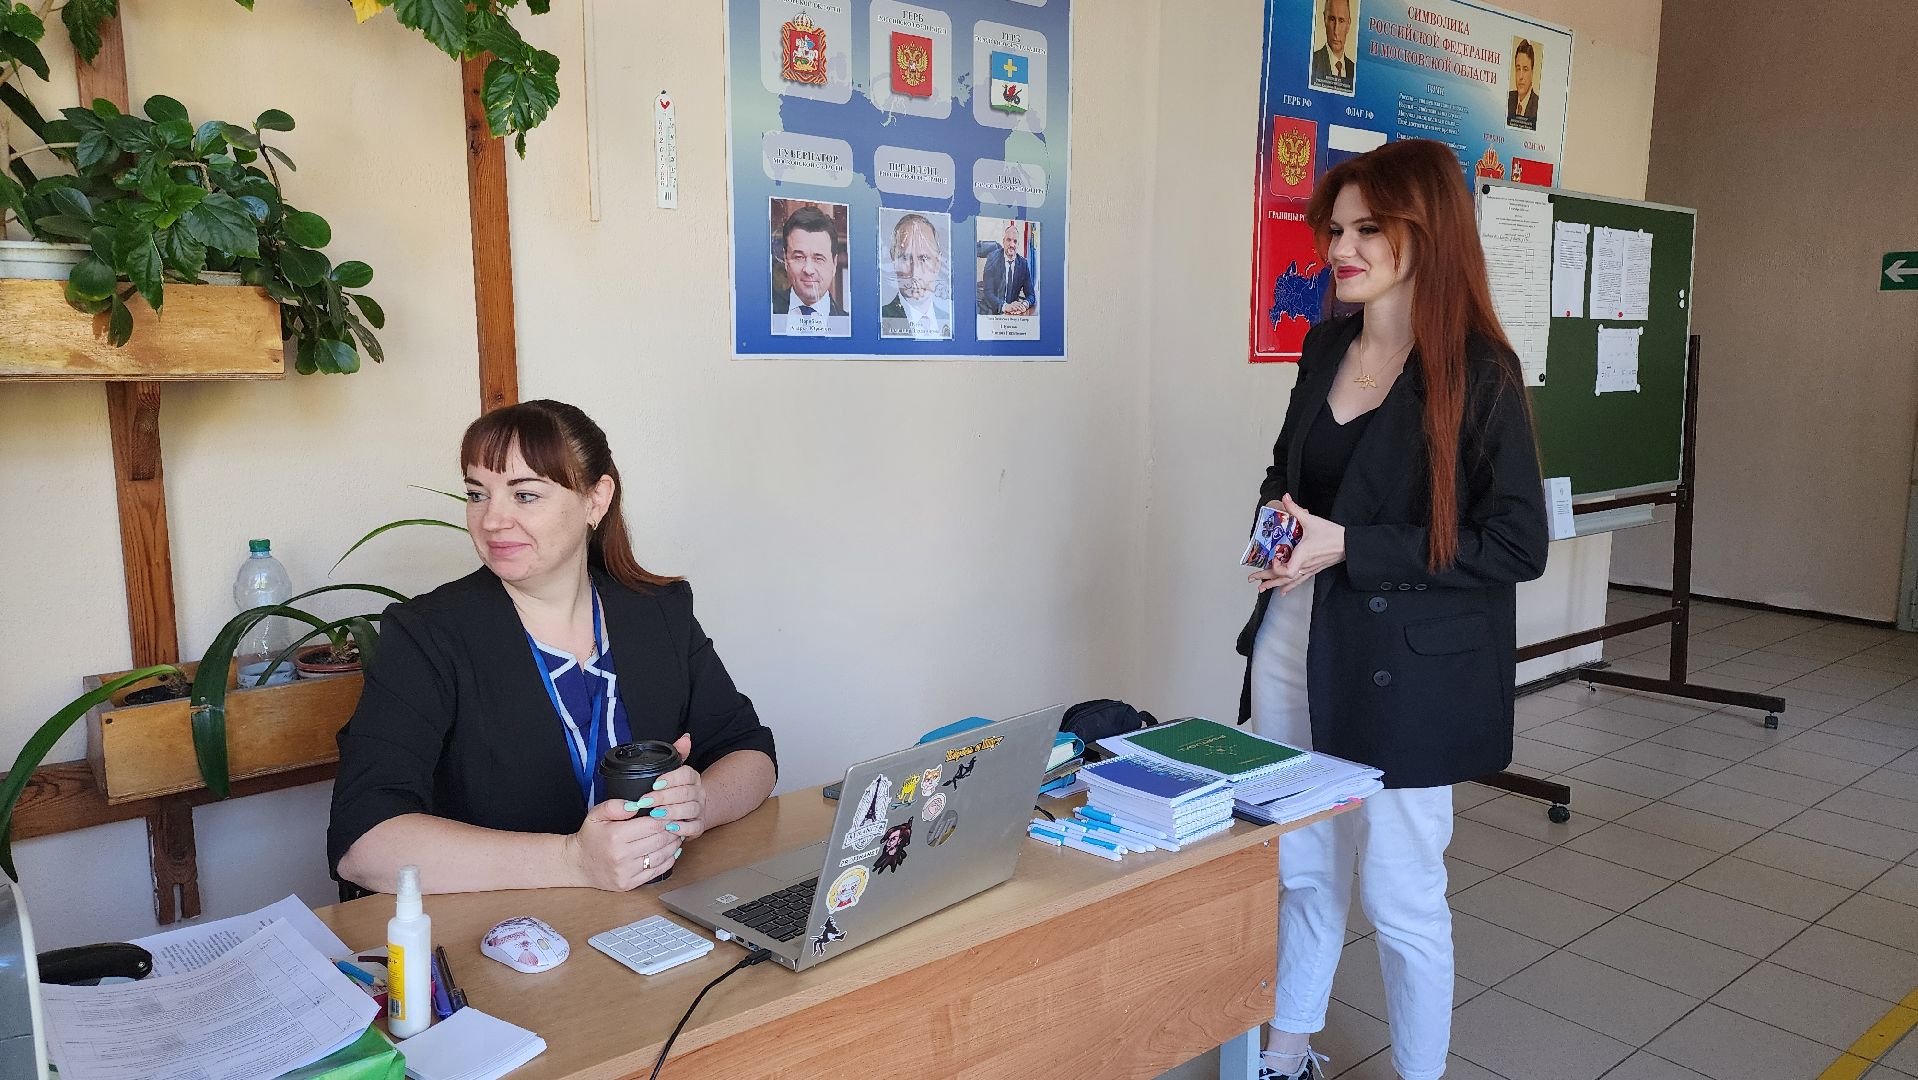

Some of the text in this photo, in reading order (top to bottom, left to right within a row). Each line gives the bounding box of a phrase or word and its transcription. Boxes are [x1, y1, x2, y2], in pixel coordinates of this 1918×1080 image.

[902, 10, 924, 22] ГЕРБ
[1407, 6, 1470, 35] СИМВОЛИКА
[1369, 17, 1500, 65] РОССИЙСКОЙ ФЕДЕРАЦИИ
[1370, 41, 1497, 84] И МОСКОВСКОЙ ОБЛАСТИ
[1283, 94, 1312, 107] ГЕРБ РФ
[1345, 106, 1363, 118] ФЛАГ
[778, 148, 839, 163] ГУБЕРНАТОР
[1268, 210, 1298, 221] ГРАНИЦЫ
